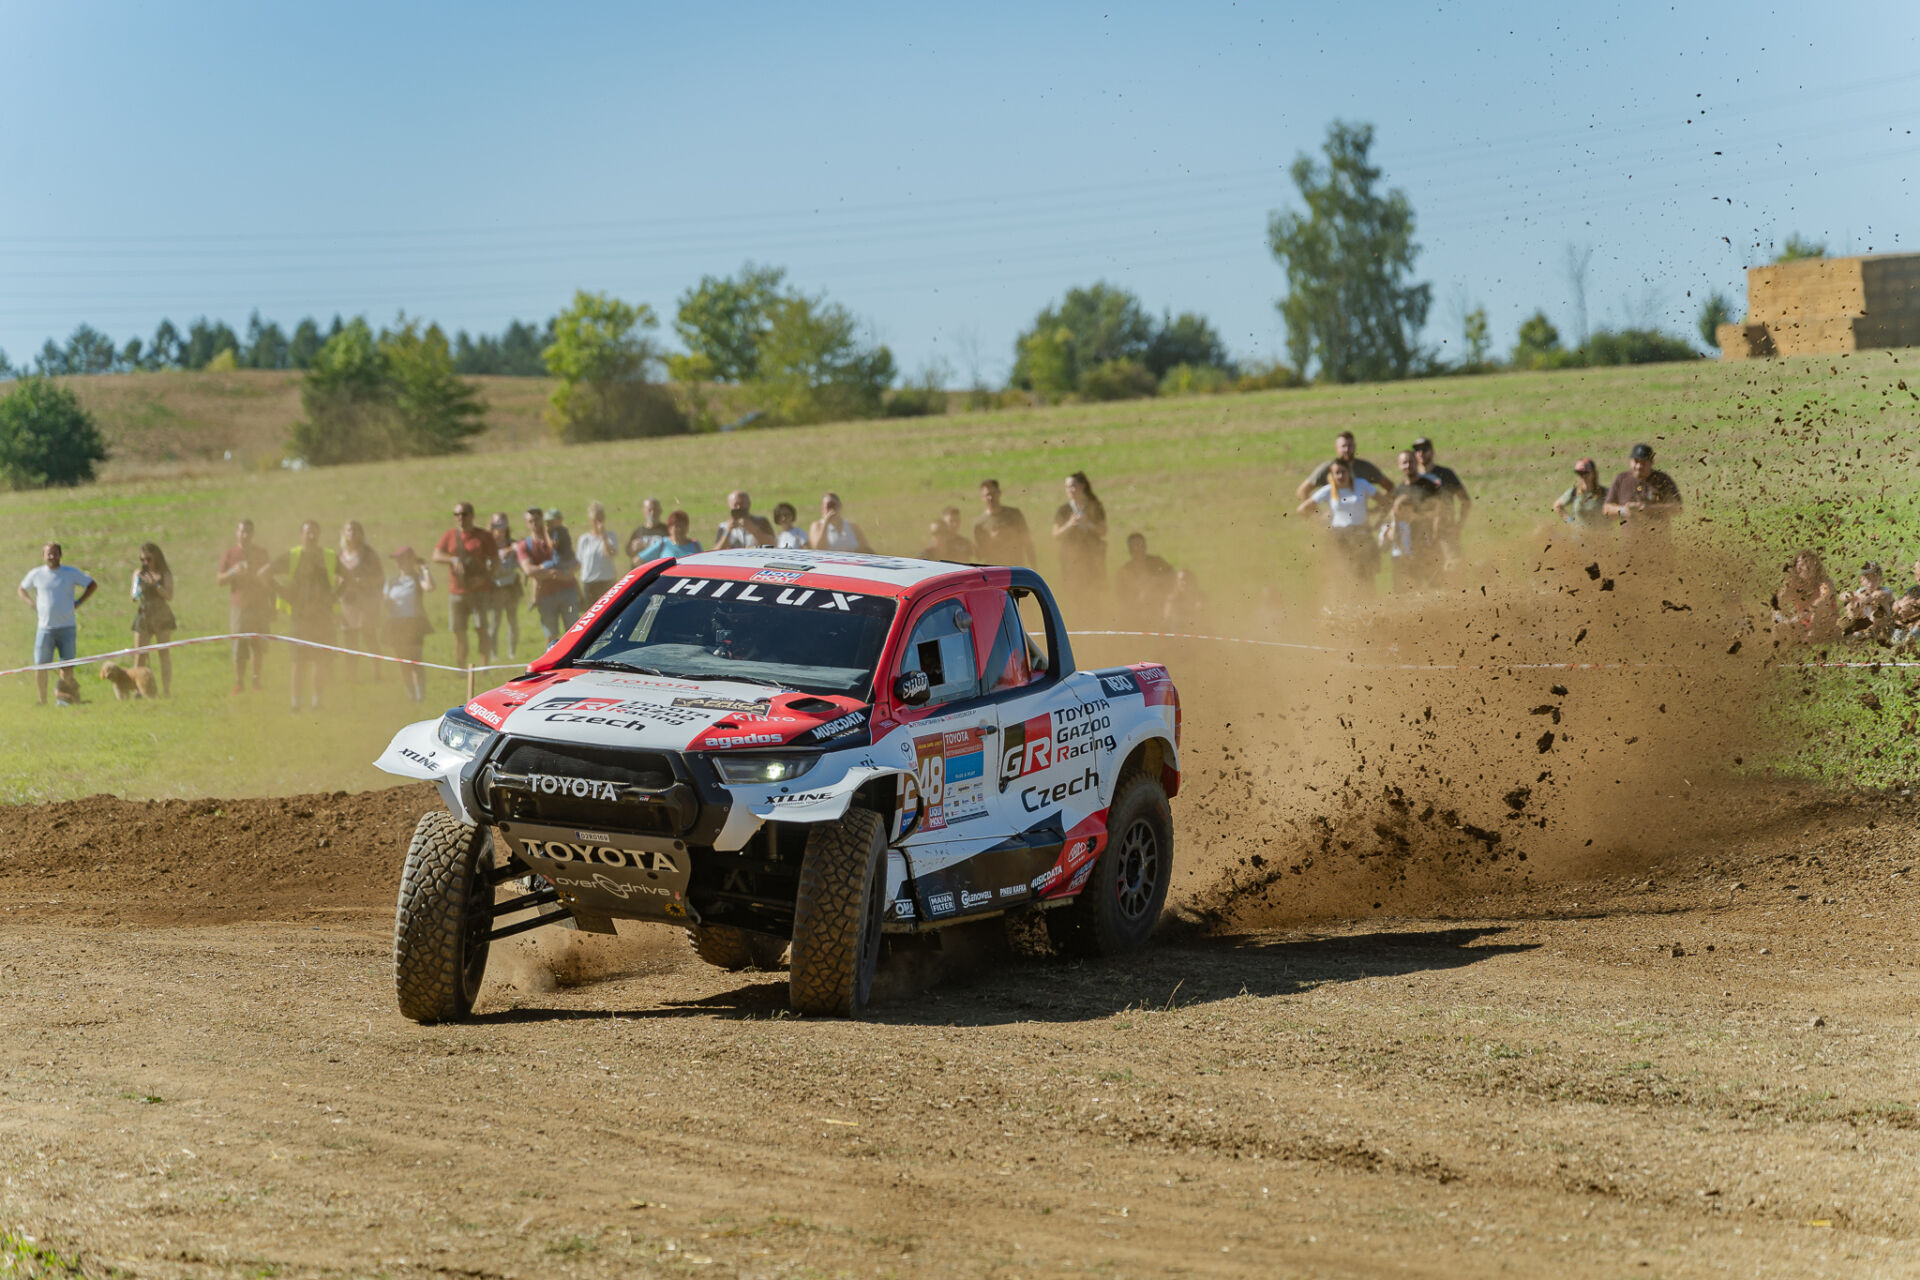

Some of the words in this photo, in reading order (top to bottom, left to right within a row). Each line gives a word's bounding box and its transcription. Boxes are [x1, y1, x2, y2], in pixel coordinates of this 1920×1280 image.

[571, 575, 634, 633] MUSICDATA
[667, 579, 864, 611] HILUX
[468, 702, 503, 725] agados
[544, 713, 646, 731] Czech
[631, 701, 711, 719] TOYOTA
[1054, 699, 1111, 725] TOYOTA
[811, 711, 867, 740] MUSICDATA
[945, 731, 969, 744] TOYOTA
[1057, 715, 1111, 744] GAZOO
[705, 733, 783, 749] agados
[1056, 735, 1117, 763] Racing
[1001, 736, 1051, 778] GR
[527, 772, 618, 802] TOYOTA
[764, 792, 834, 805] XTLINE
[1021, 767, 1099, 813] Czech
[519, 839, 680, 873] TOYOTA
[931, 894, 952, 905] MANN
[933, 901, 954, 912] FILTER
